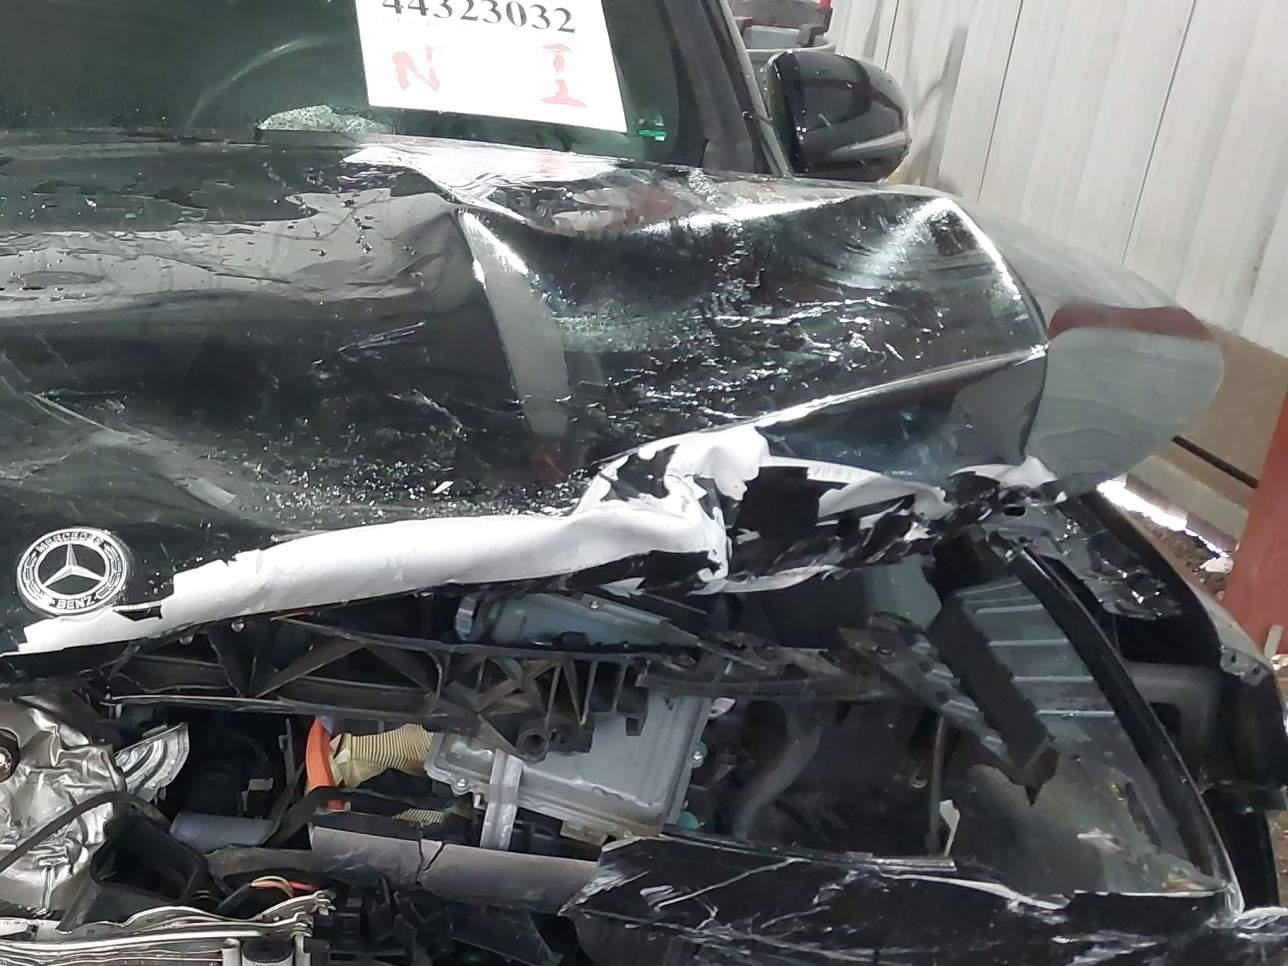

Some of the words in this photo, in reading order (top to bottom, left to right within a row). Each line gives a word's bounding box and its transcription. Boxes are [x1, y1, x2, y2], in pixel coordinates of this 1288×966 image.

[382, 0, 576, 33] 44323032
[392, 45, 440, 92] N
[56, 595, 94, 609] BENZ
